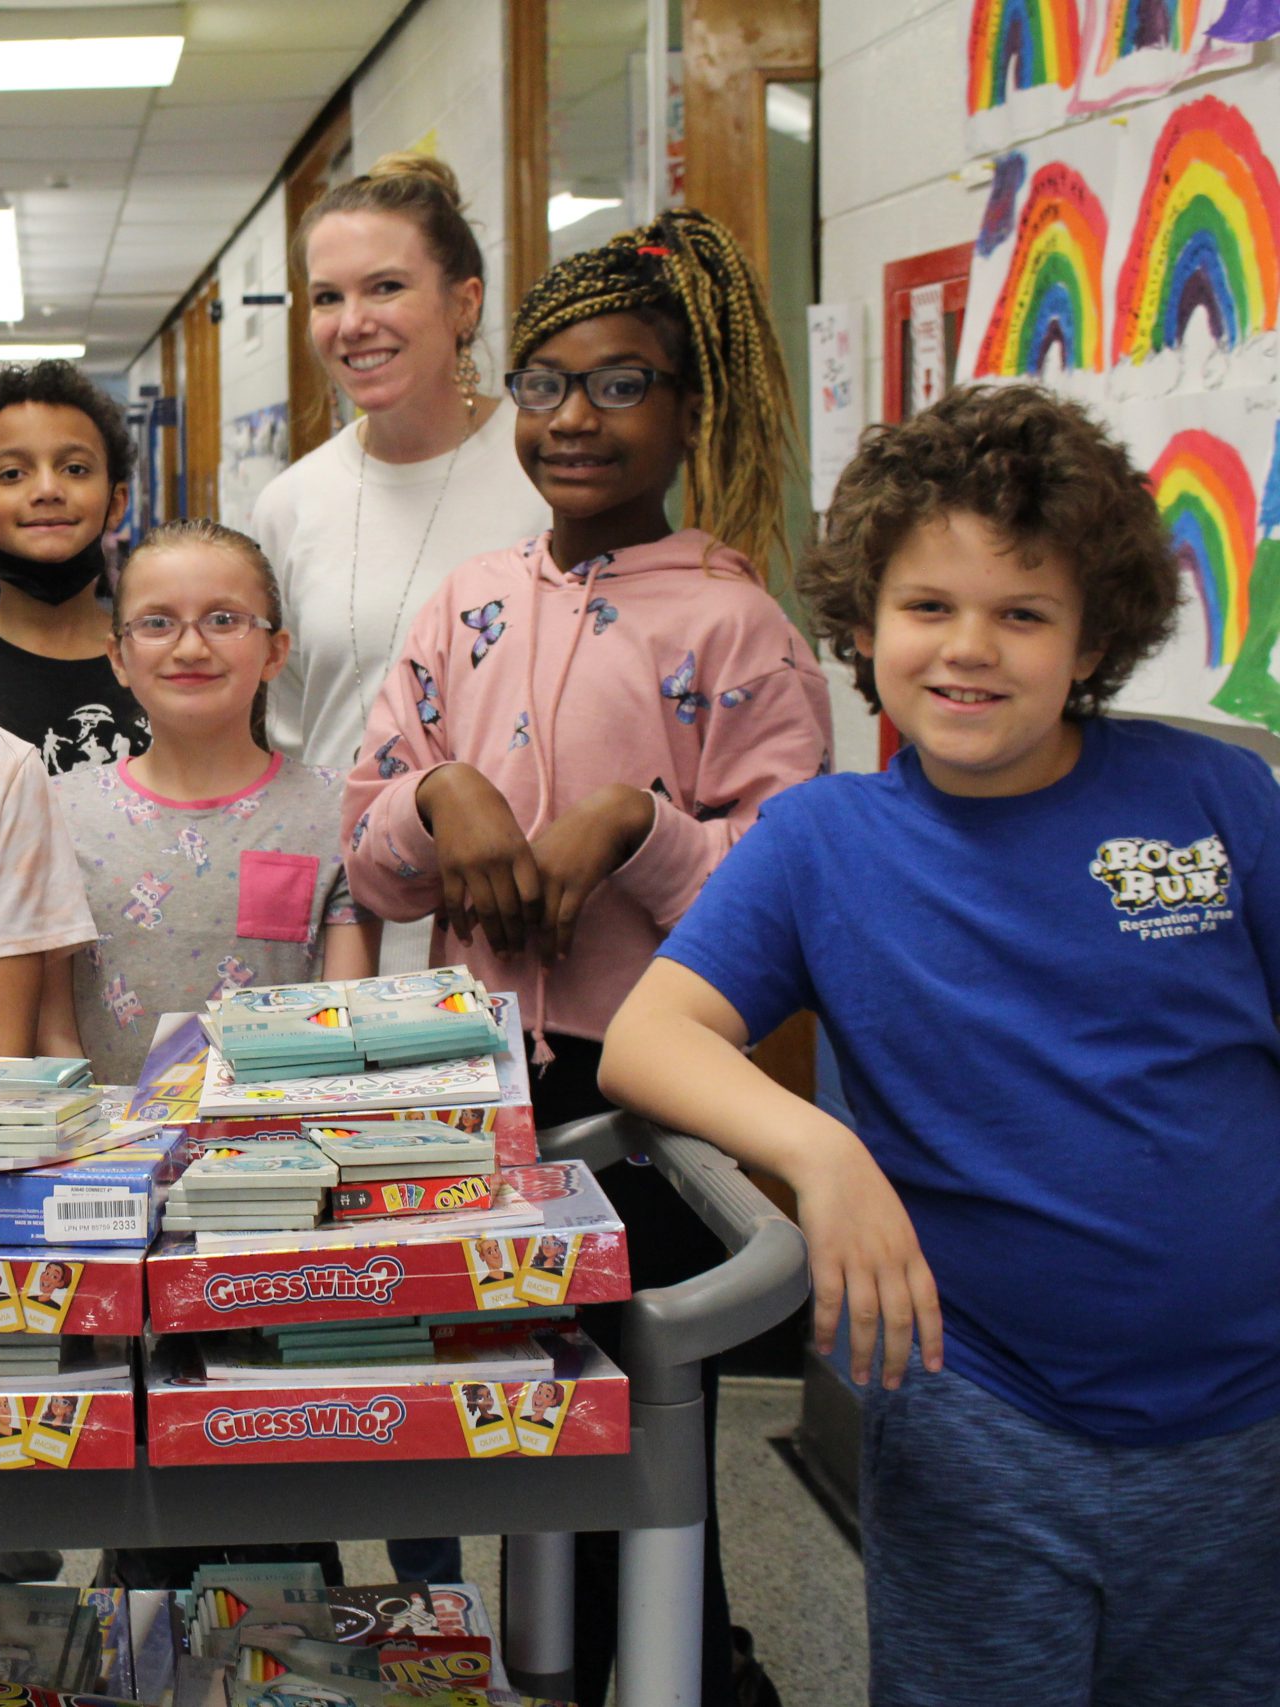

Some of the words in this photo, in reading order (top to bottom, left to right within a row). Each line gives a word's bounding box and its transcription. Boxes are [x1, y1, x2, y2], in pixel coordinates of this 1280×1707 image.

[1104, 839, 1228, 874] ROCK
[1119, 870, 1221, 903] RUN
[1120, 911, 1199, 932] Recreation
[1205, 910, 1233, 921] Area
[1200, 921, 1217, 932] PA
[435, 1177, 489, 1210] UNO
[112, 1220, 137, 1231] 2333
[208, 1274, 306, 1308] Guess
[305, 1259, 400, 1301] Who?
[209, 1411, 307, 1443] Guess
[306, 1399, 402, 1439] Who?
